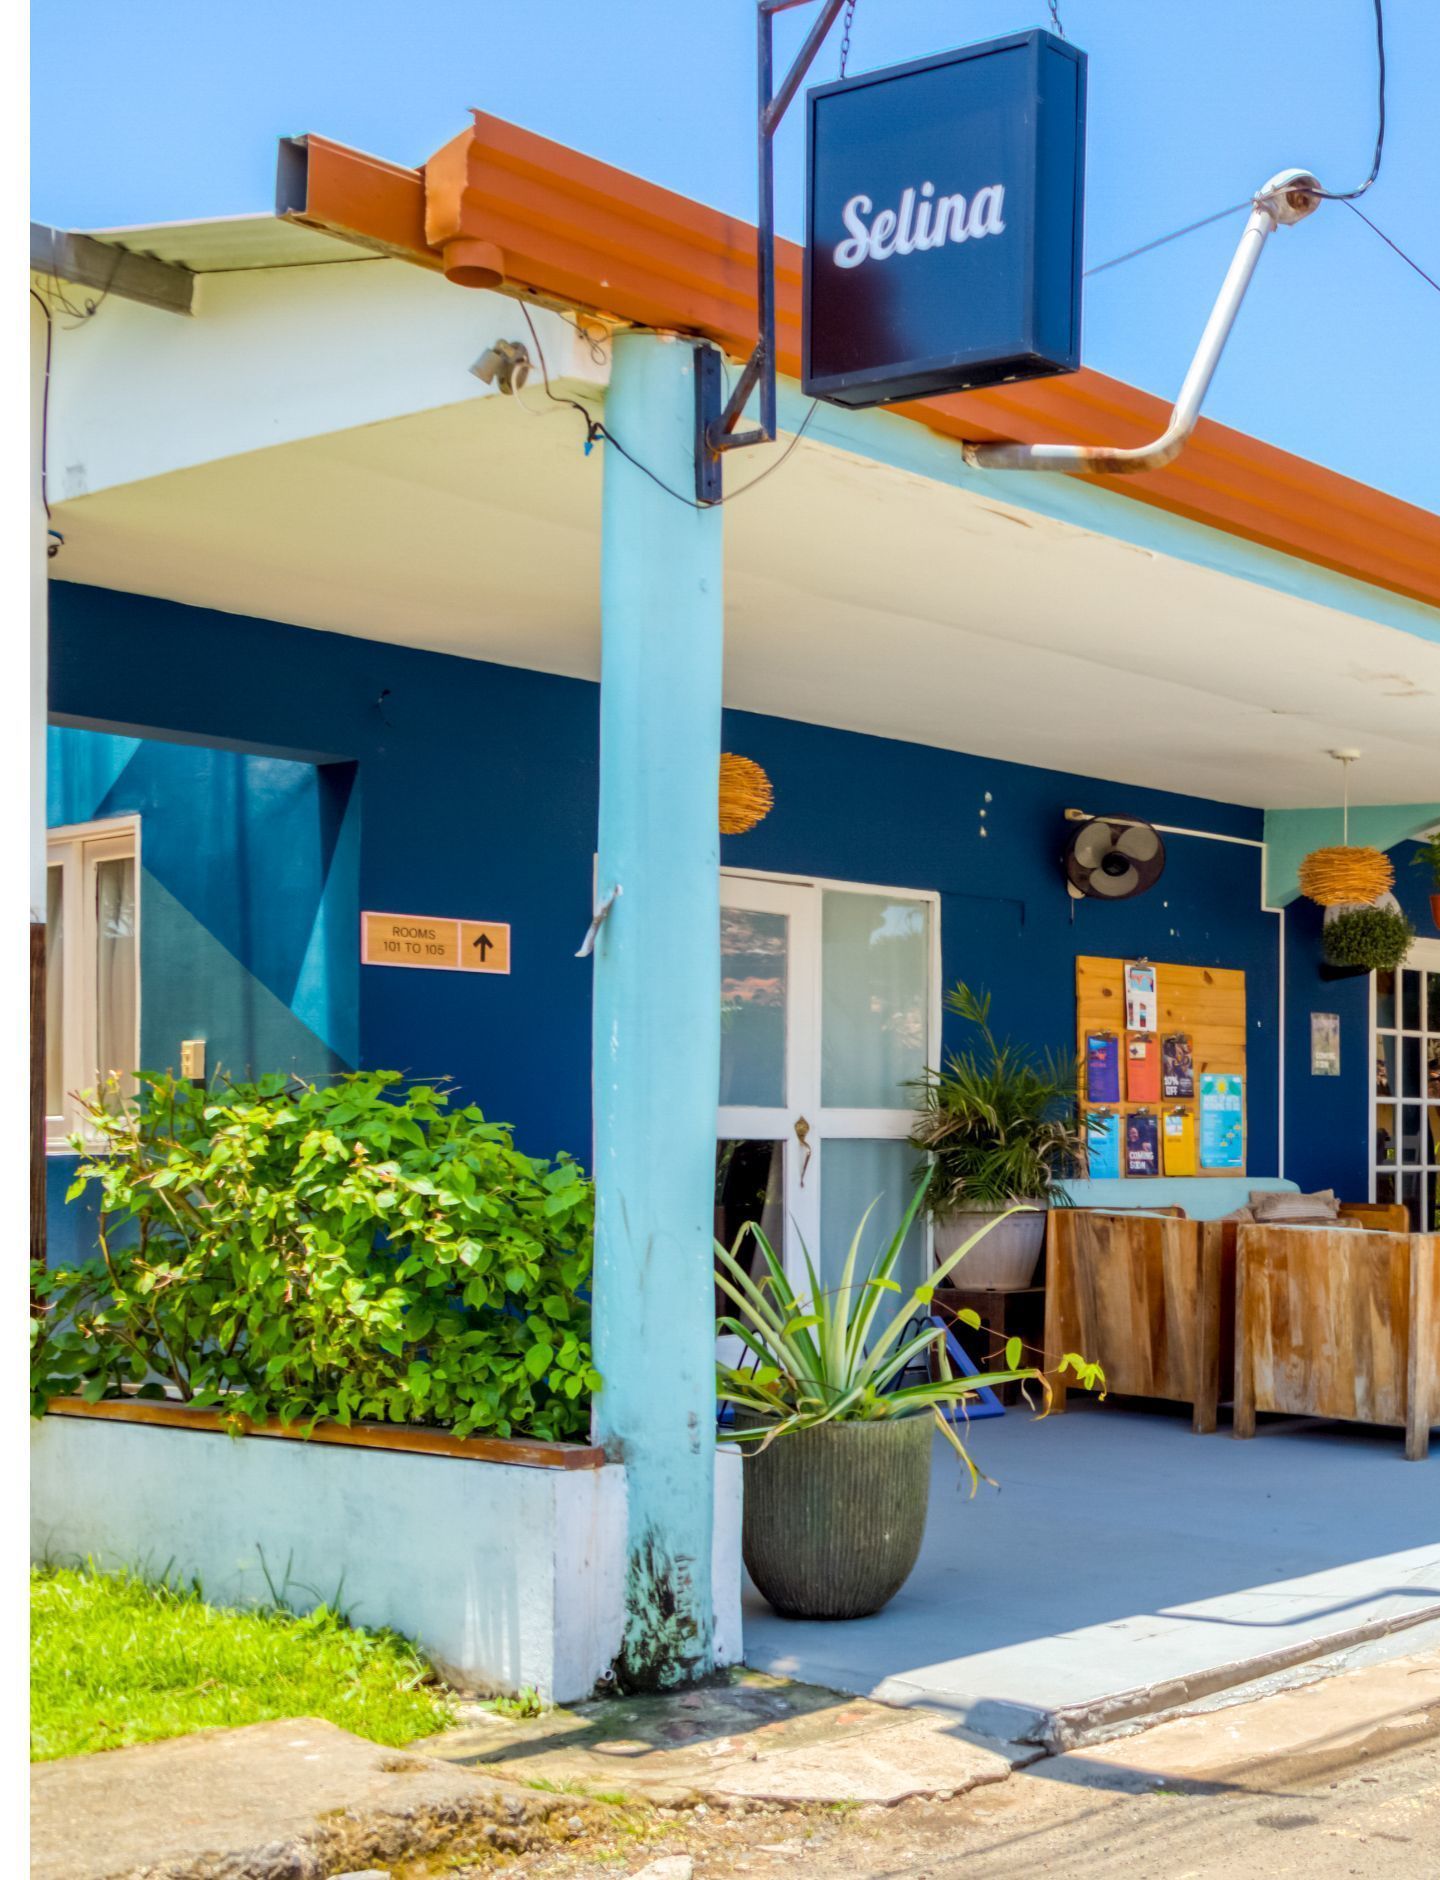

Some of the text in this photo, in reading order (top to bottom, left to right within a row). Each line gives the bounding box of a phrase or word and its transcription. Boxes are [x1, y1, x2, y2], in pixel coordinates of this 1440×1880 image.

[832, 181, 1006, 269] Selina
[392, 926, 437, 940] ROOMS
[384, 941, 446, 956] 101 TO 105
[1165, 1086, 1178, 1096] OFF
[1129, 1151, 1154, 1160] COMING
[1129, 1160, 1146, 1170] SOON
